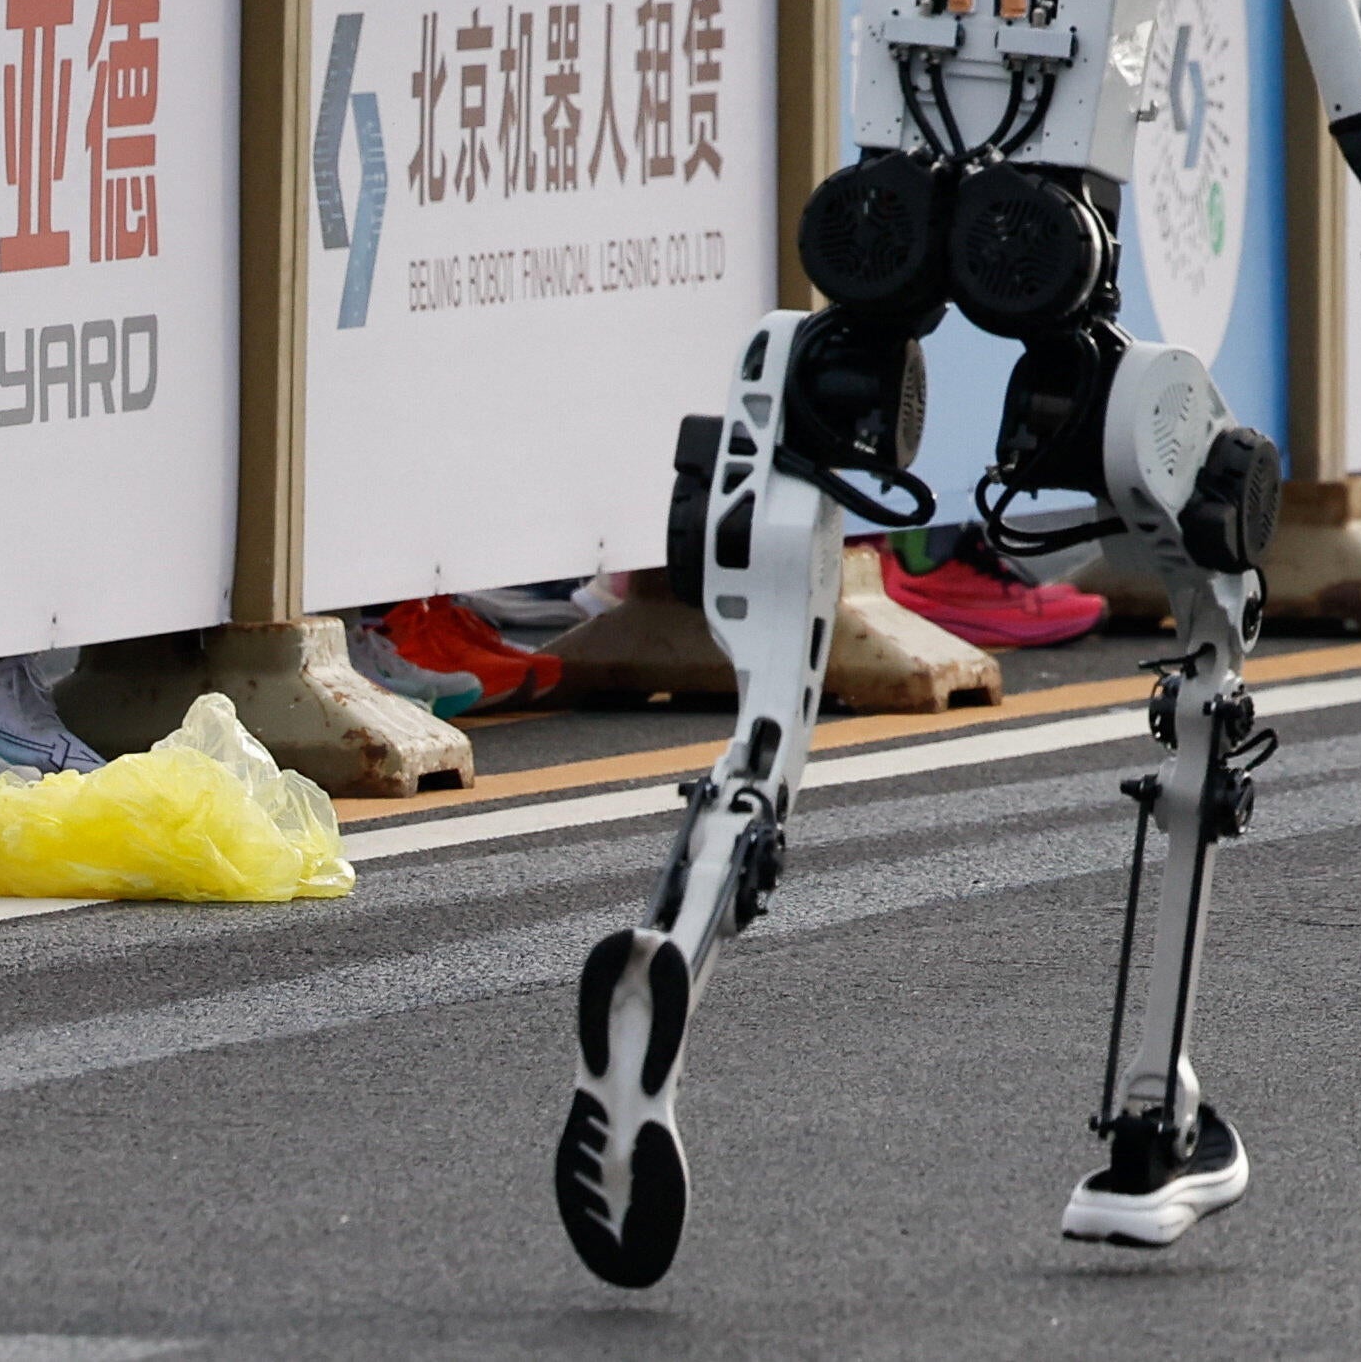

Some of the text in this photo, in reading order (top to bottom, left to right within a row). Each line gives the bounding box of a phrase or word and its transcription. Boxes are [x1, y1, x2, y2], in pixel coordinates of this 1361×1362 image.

[409, 256, 462, 311] BEIJING
[469, 251, 515, 304] ROBOT
[522, 245, 593, 298] FINANCIAL
[601, 238, 660, 290] LEASING
